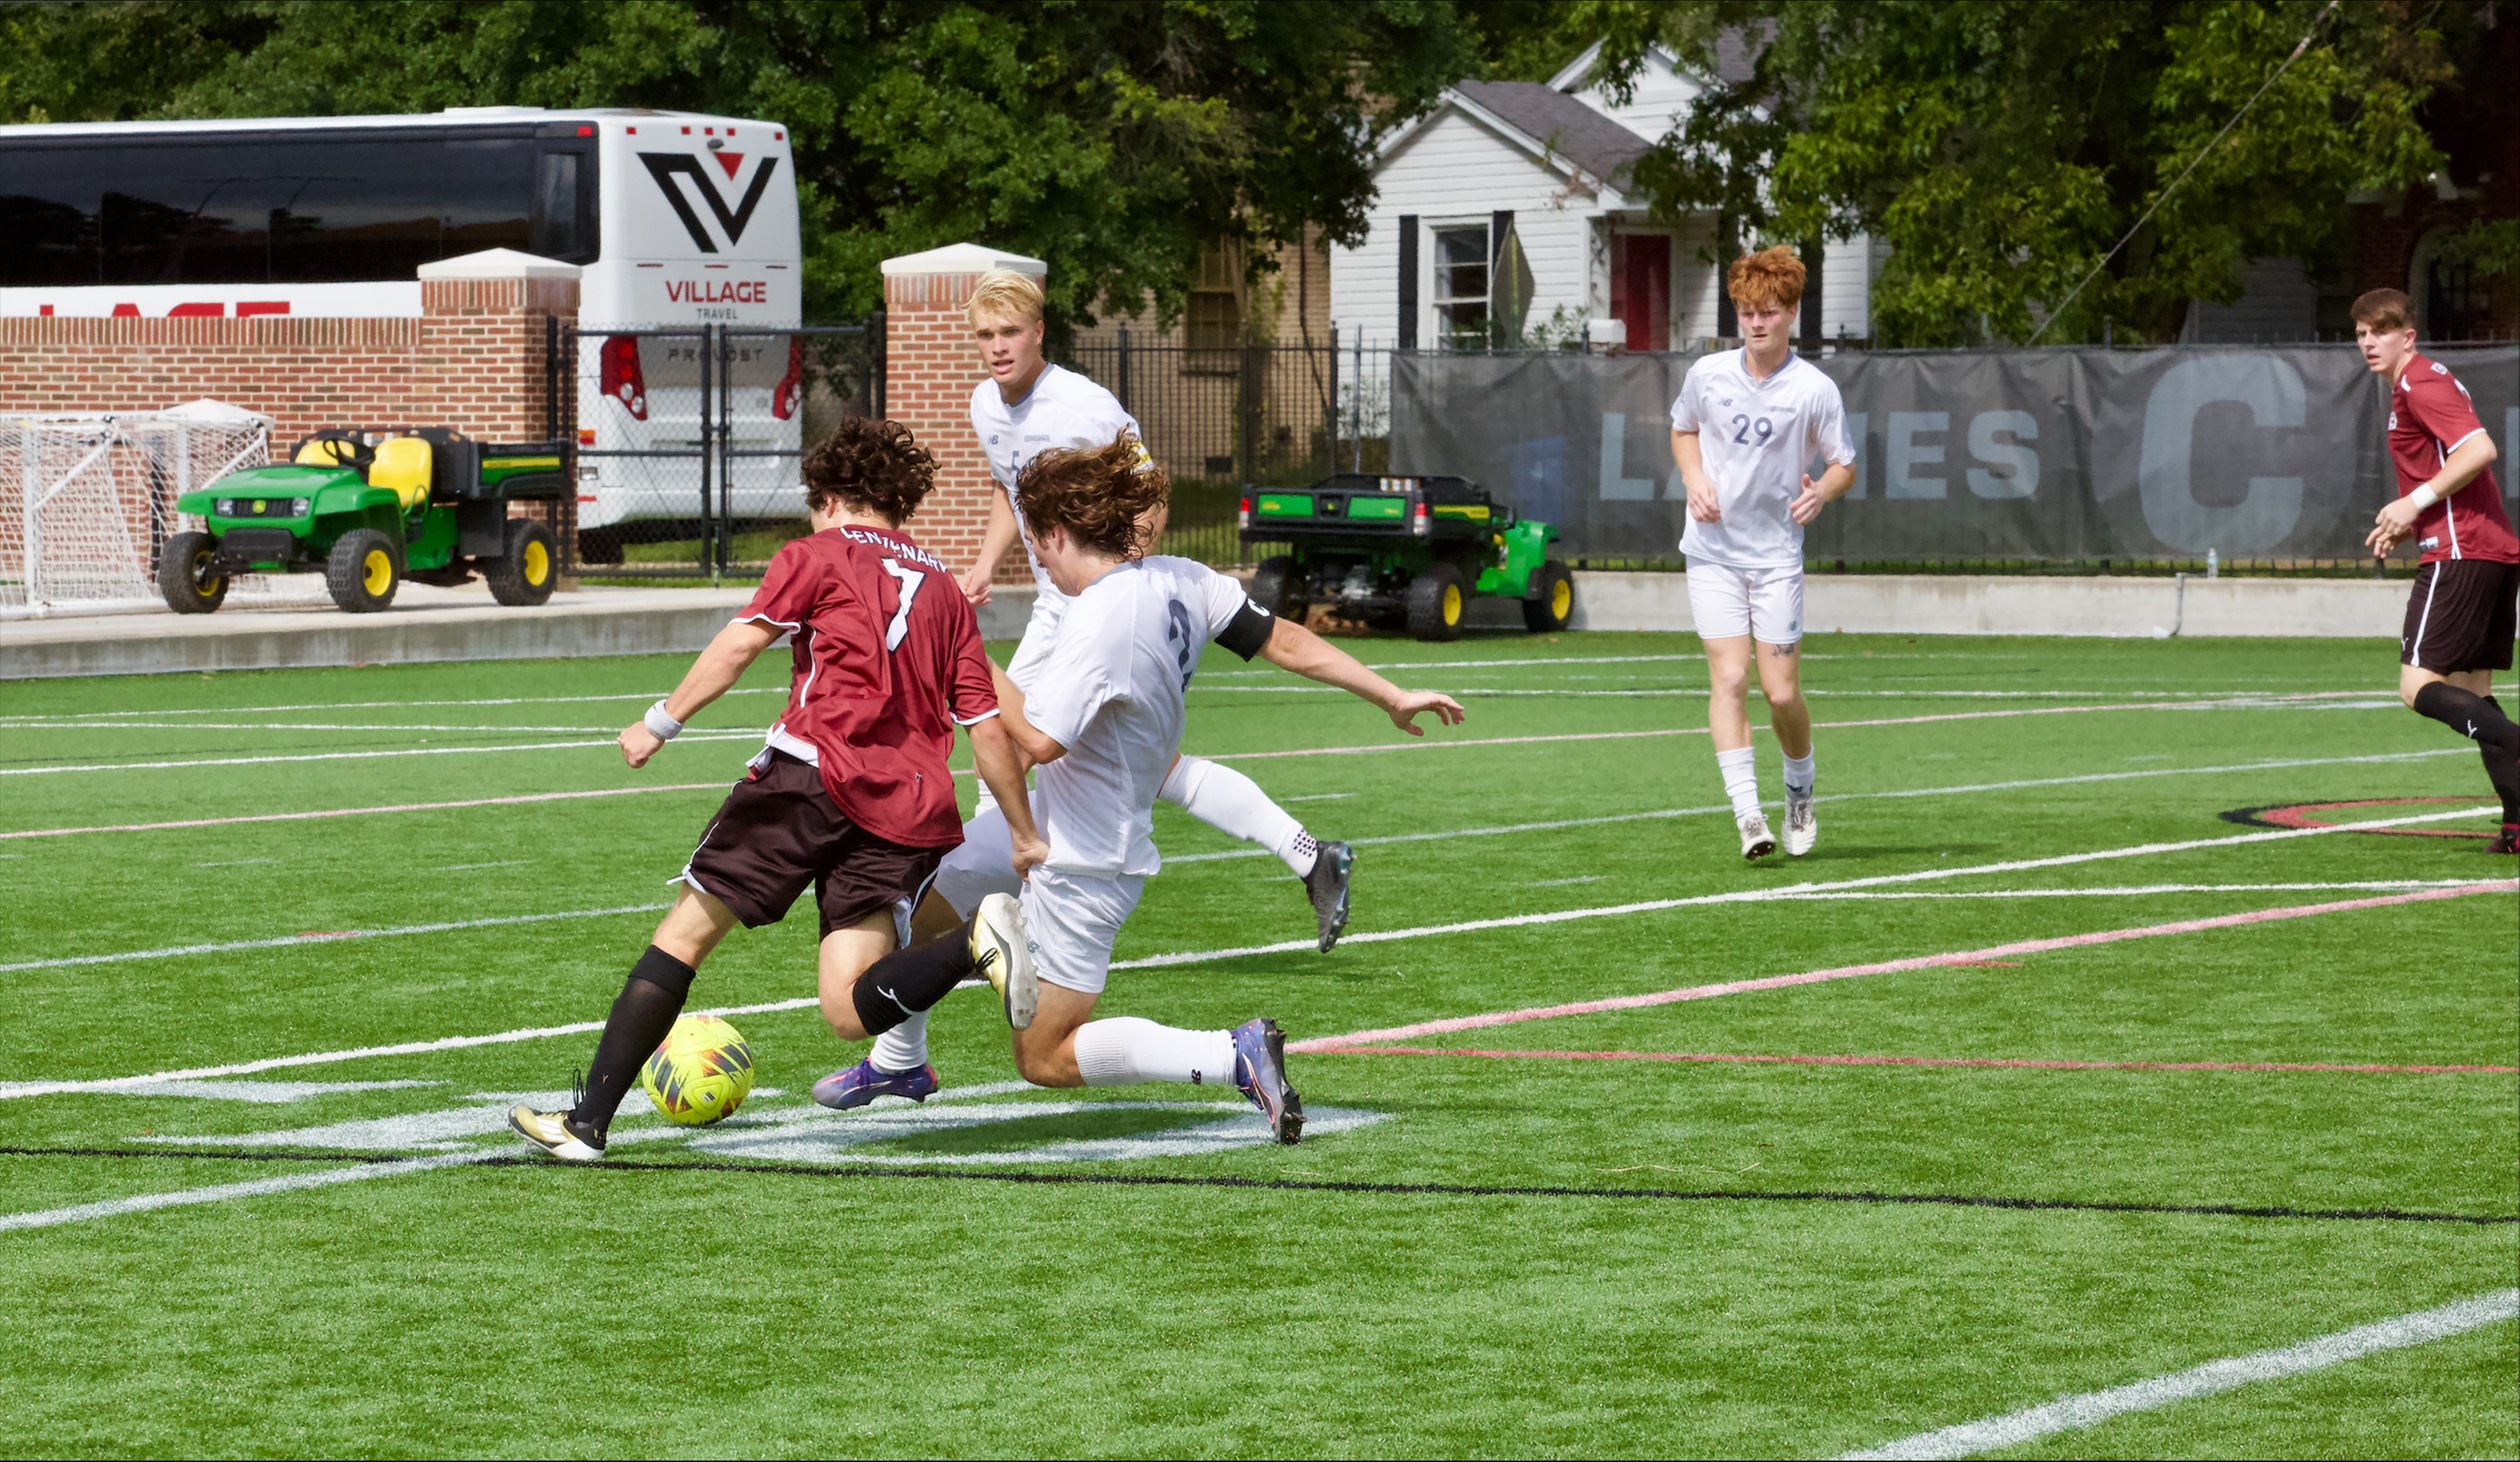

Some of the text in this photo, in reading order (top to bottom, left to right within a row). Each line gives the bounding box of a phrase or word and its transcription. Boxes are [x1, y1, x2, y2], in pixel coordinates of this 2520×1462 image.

[665, 281, 767, 303] VILLAGE
[697, 308, 738, 320] TRAVEL
[1732, 414, 1773, 447] 29
[2139, 355, 2306, 553] C
[881, 557, 926, 653] 7
